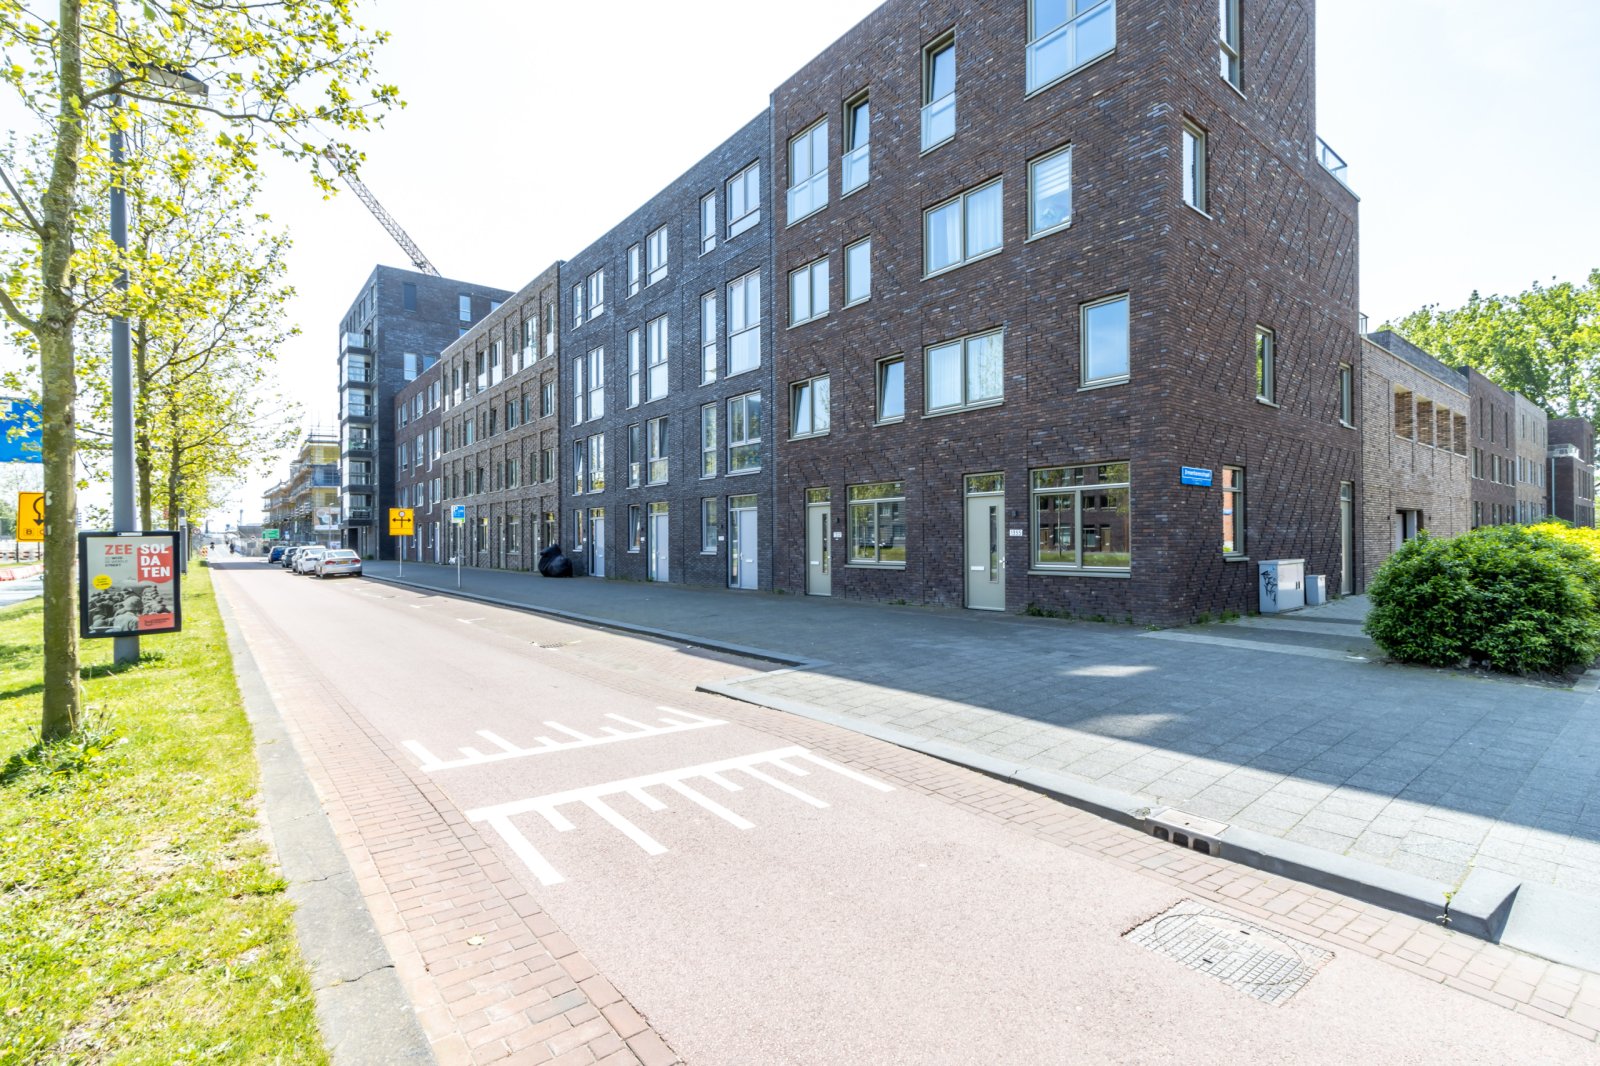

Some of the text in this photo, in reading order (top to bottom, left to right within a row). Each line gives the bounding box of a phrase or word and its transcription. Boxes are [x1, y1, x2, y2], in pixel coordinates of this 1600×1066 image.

[104, 544, 133, 555] ZEE
[140, 543, 169, 554] SOL
[140, 555, 161, 566] DA
[140, 566, 171, 578] TEN
